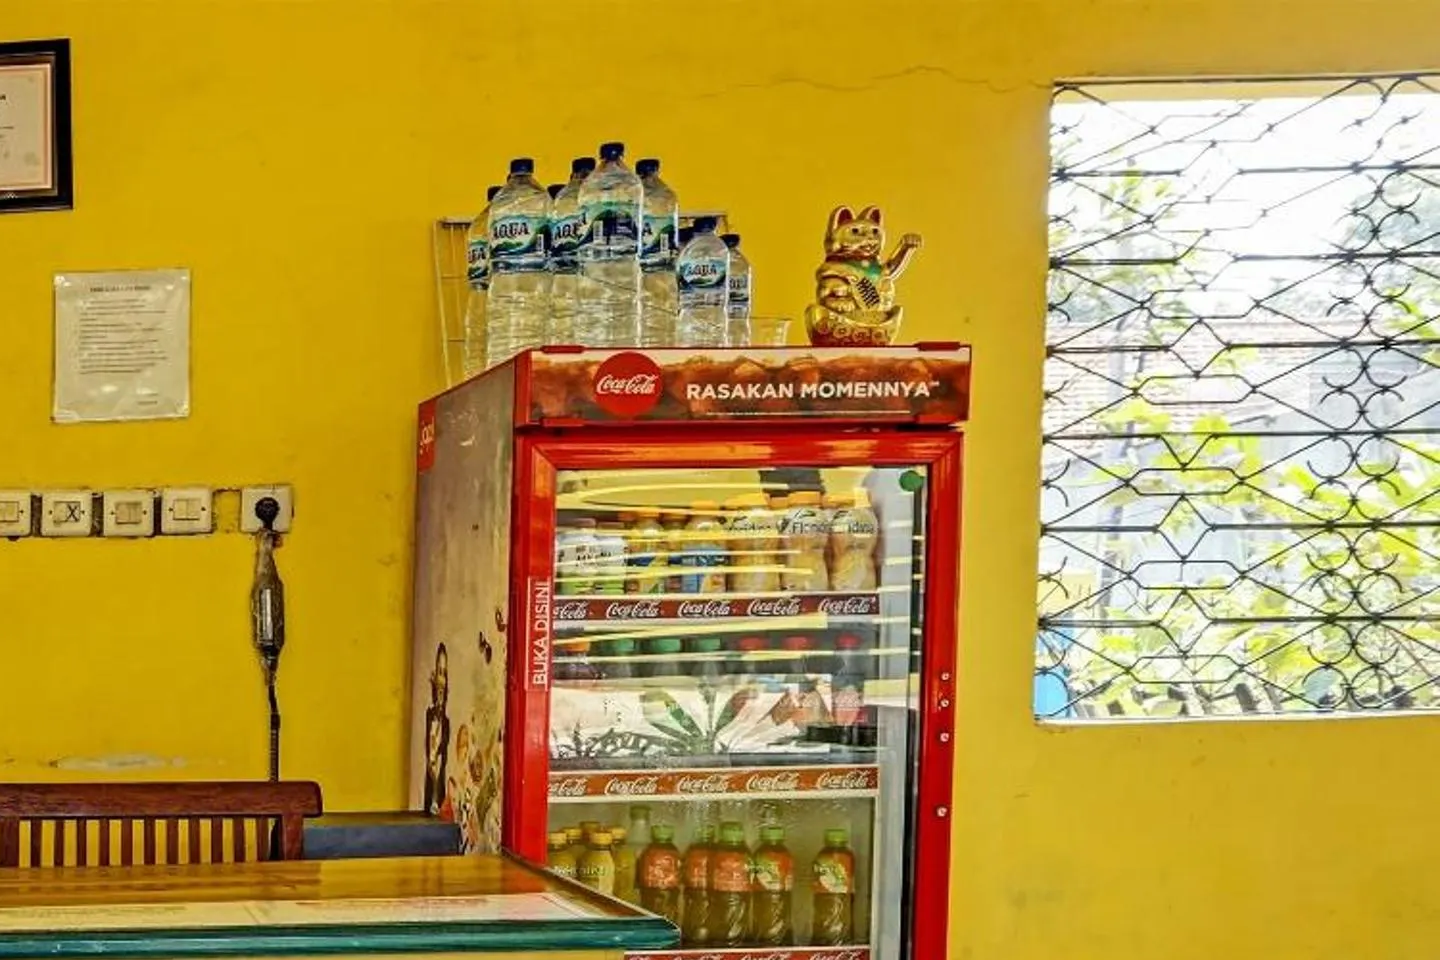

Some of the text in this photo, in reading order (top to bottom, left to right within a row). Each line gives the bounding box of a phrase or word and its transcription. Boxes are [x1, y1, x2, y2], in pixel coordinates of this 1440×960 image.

[595, 373, 660, 396] Coca-Cola
[686, 380, 931, 401] RASAKAN MOMENNYA
[532, 581, 549, 685] BUKA DISINI
